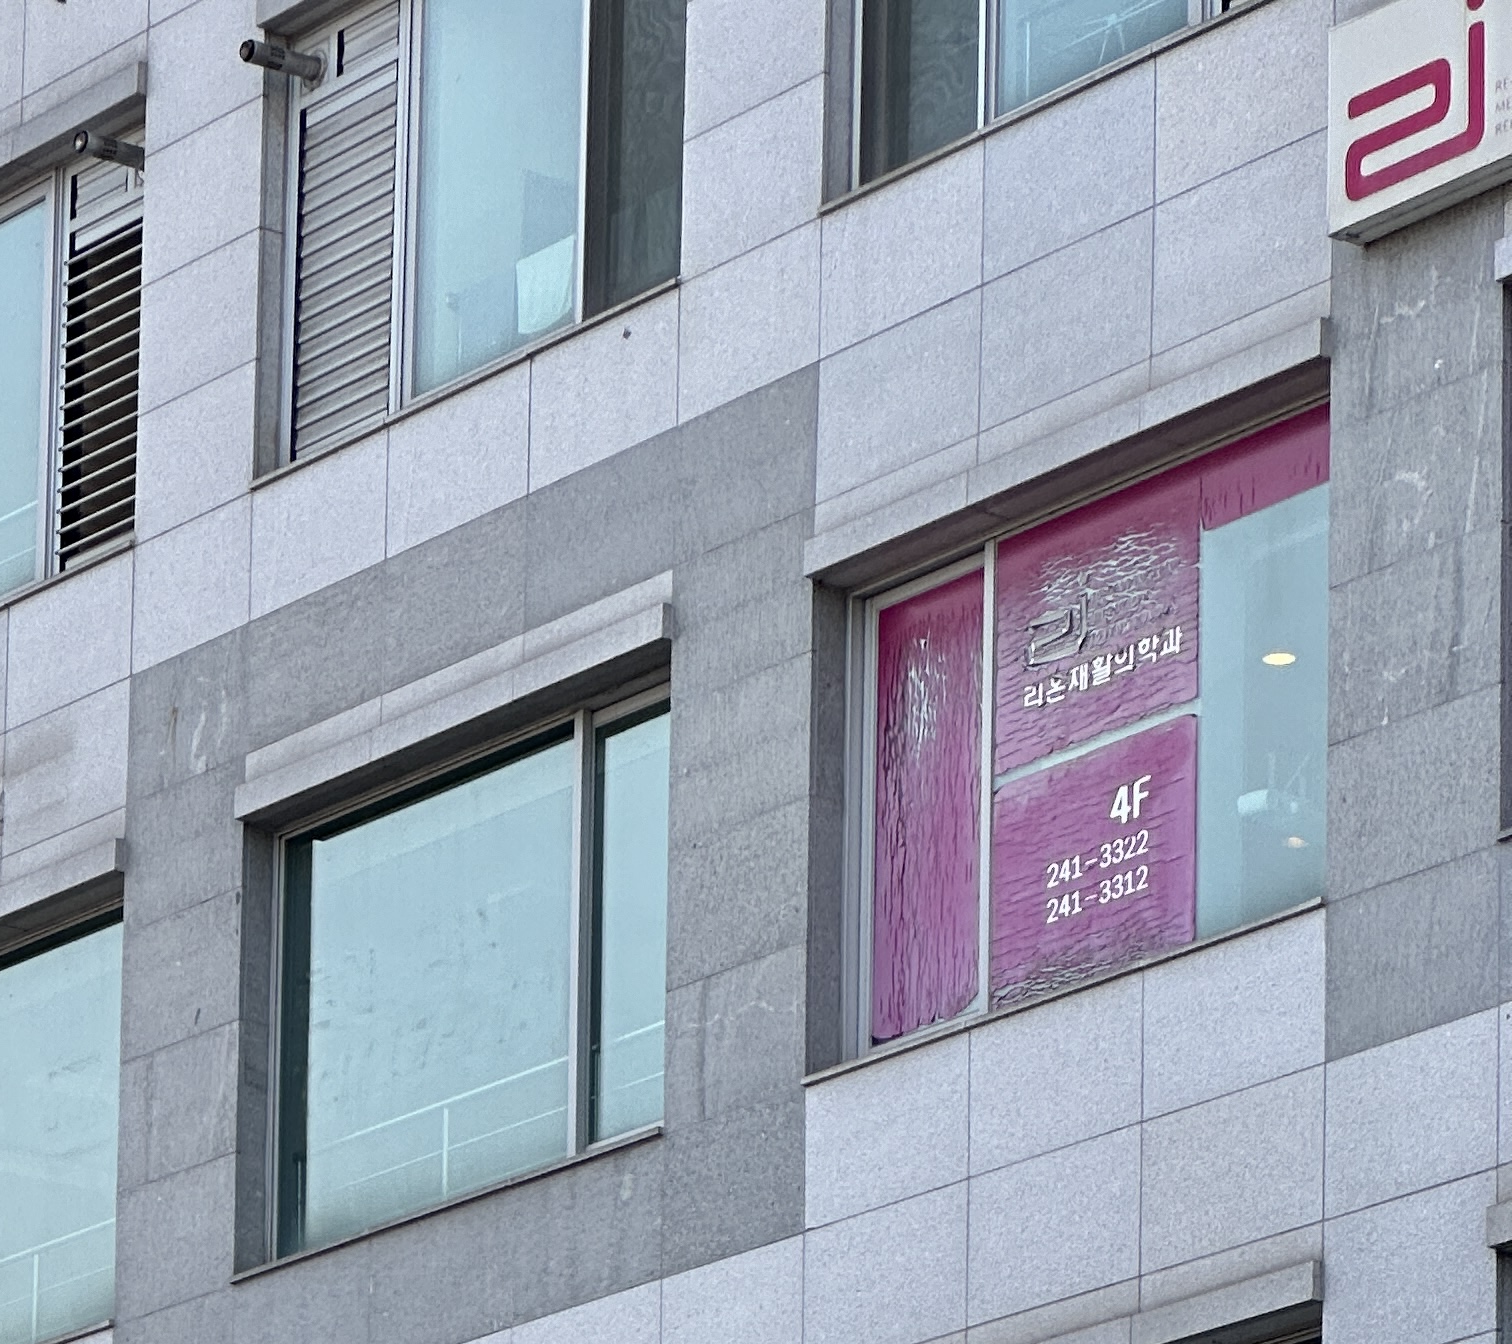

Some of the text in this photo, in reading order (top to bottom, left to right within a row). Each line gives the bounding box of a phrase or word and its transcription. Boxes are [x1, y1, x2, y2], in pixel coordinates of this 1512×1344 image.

[1022, 626, 1184, 708] 리온재활의학과
[1109, 775, 1152, 824] 4F
[1046, 829, 1149, 889] 241-3322
[1046, 864, 1149, 924] 241-3312
